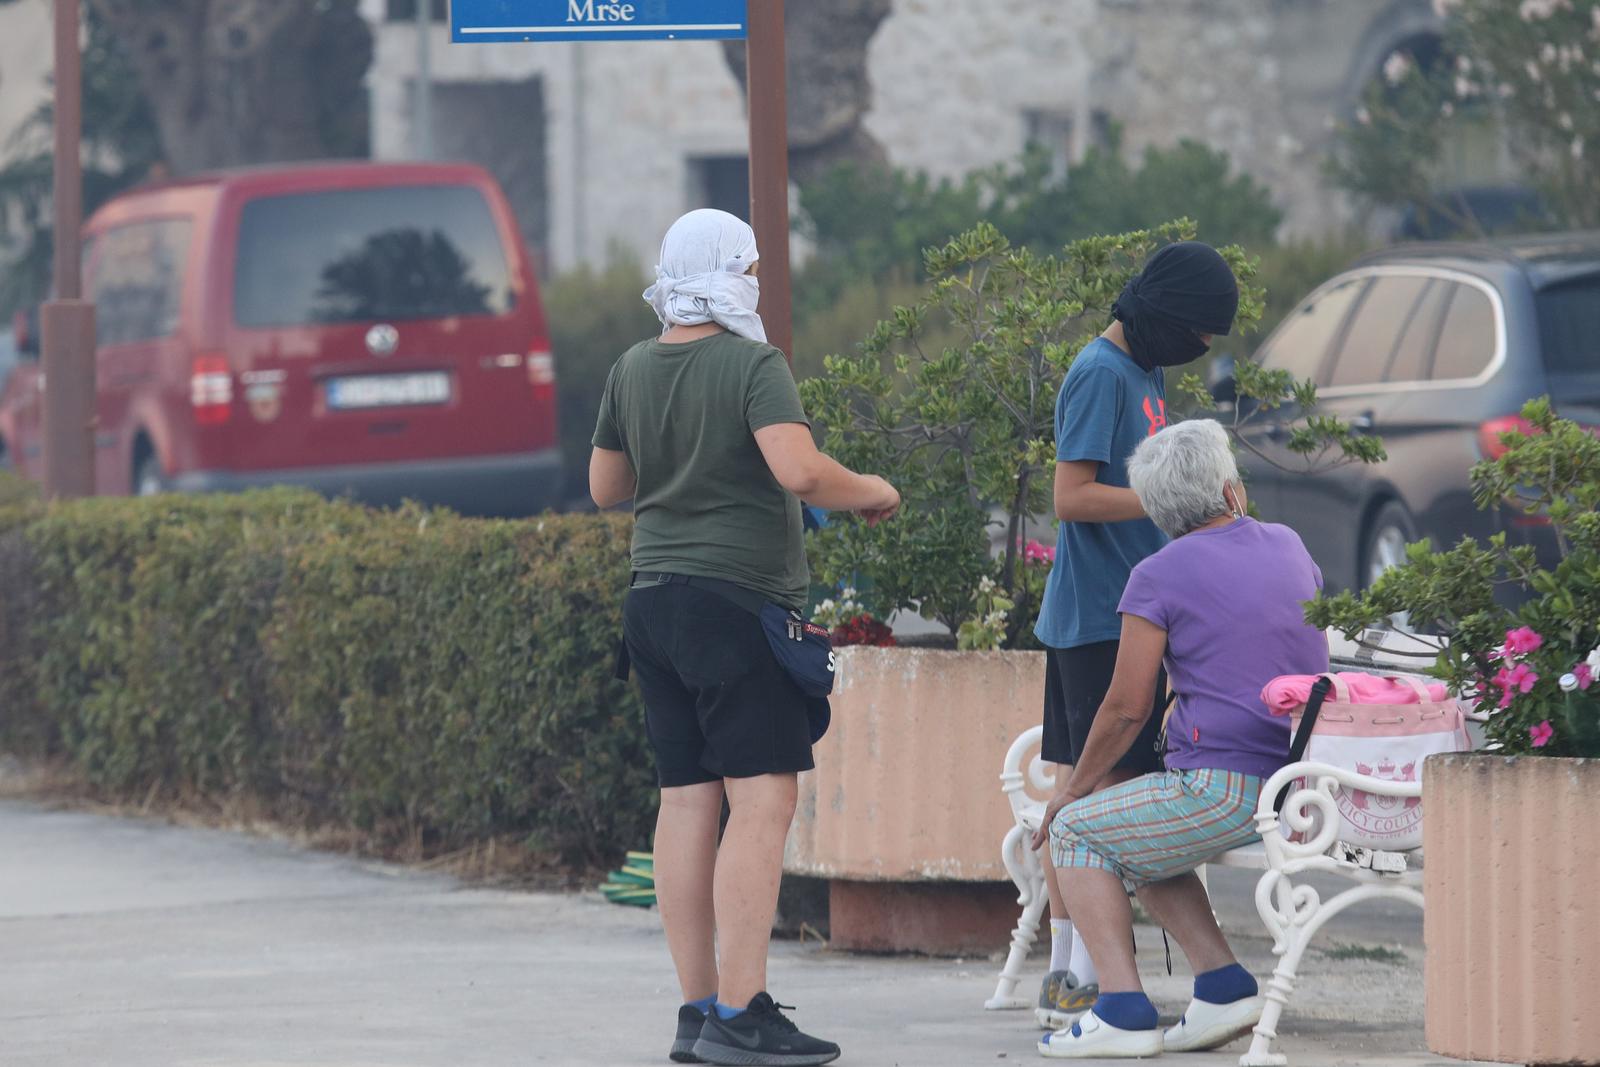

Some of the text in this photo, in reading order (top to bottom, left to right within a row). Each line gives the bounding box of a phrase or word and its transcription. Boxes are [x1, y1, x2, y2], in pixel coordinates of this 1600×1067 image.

[566, 0, 636, 22] Mrše
[826, 650, 836, 672] S
[1374, 806, 1424, 831] COUTU
